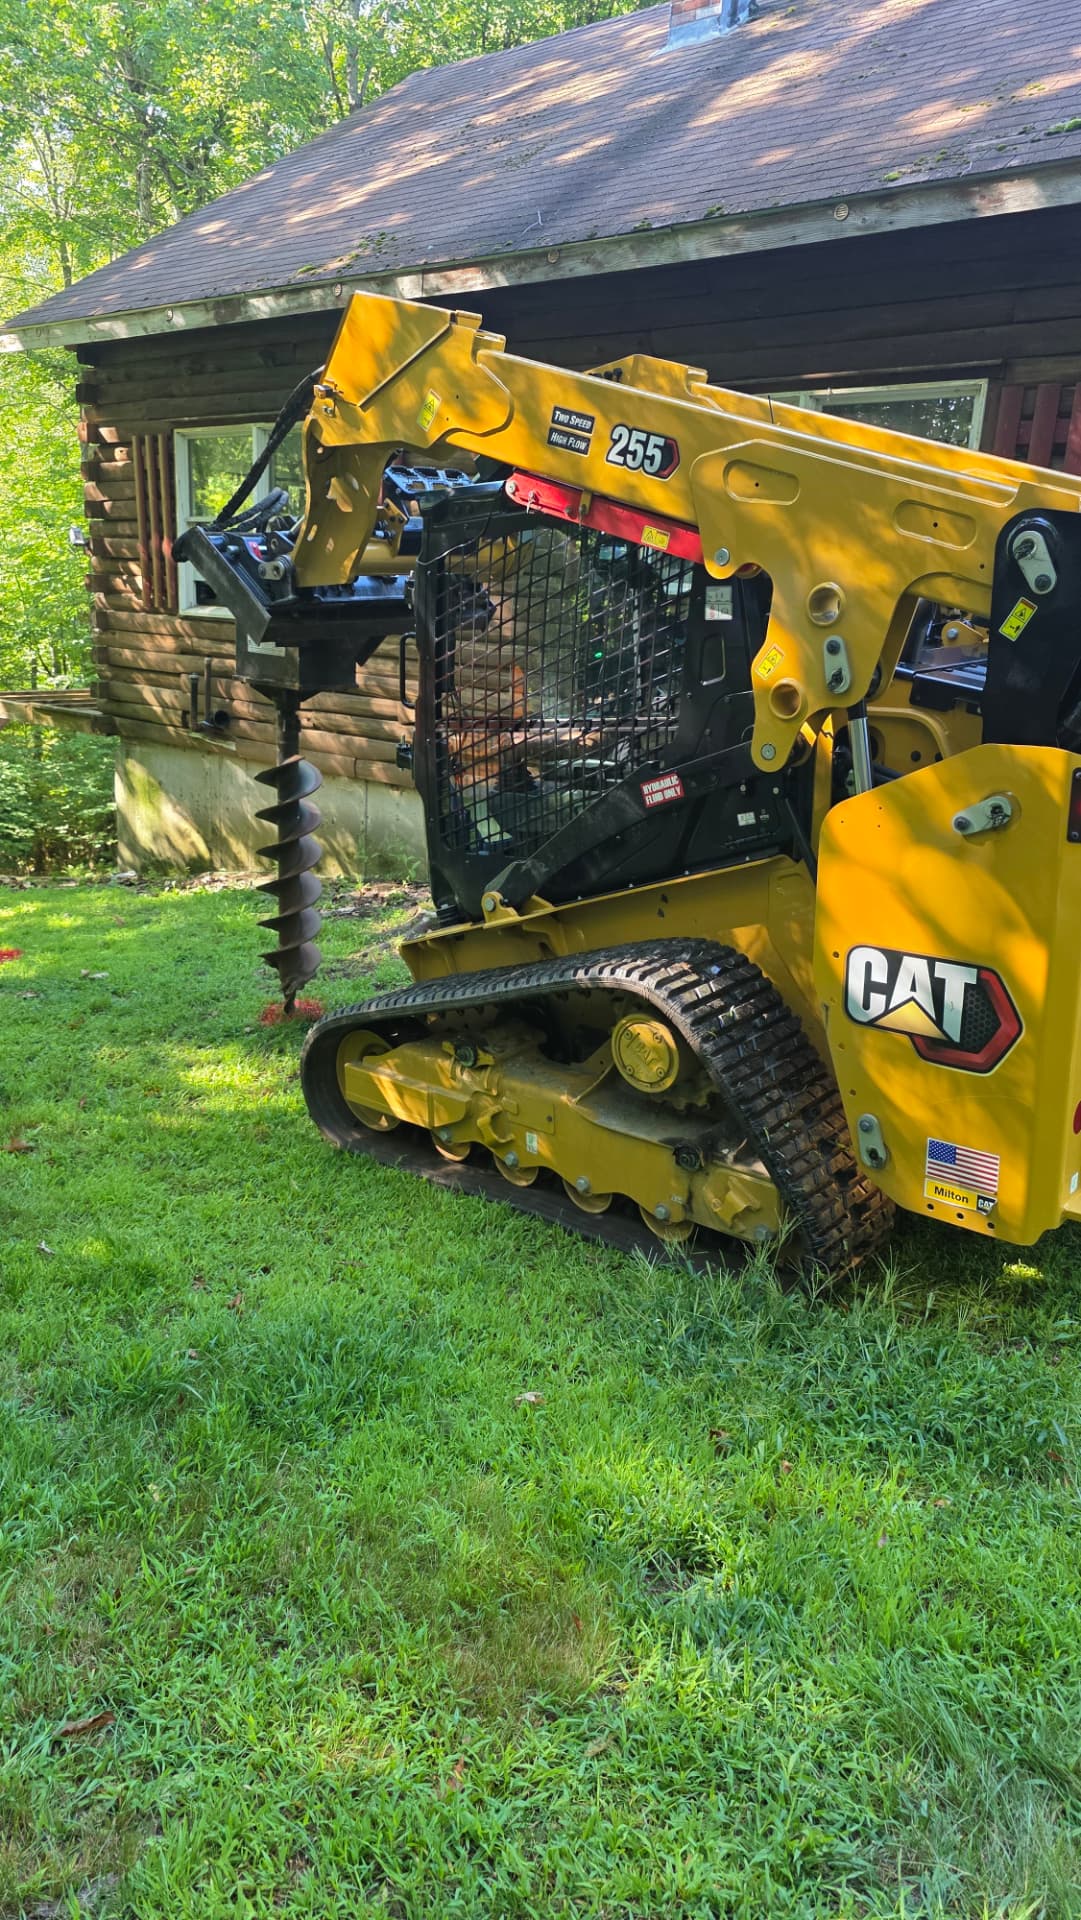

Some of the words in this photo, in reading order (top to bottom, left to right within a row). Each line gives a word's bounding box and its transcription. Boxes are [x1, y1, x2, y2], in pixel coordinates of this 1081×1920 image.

[608, 425, 665, 473] 255
[642, 775, 680, 795] HYDRAULIC
[645, 791, 664, 805] FLUID
[663, 785, 681, 799] ONLY
[848, 946, 977, 1043] CAT
[934, 1185, 969, 1204] Milton
